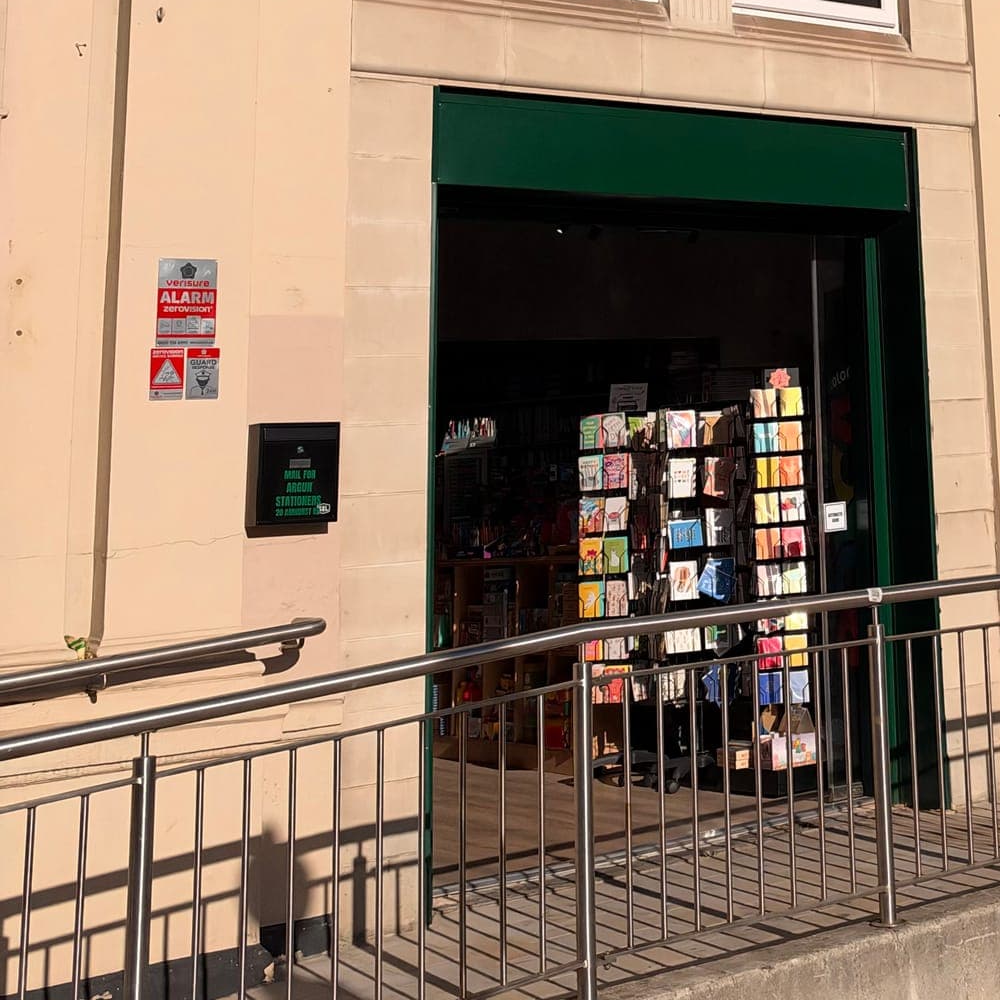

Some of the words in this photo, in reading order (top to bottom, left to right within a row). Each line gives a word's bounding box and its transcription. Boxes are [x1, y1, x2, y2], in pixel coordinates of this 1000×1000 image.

[166, 279, 210, 288] verisure
[160, 291, 215, 304] ALARM
[286, 482, 313, 493] ARGUN
[275, 495, 322, 507] STATIONERS
